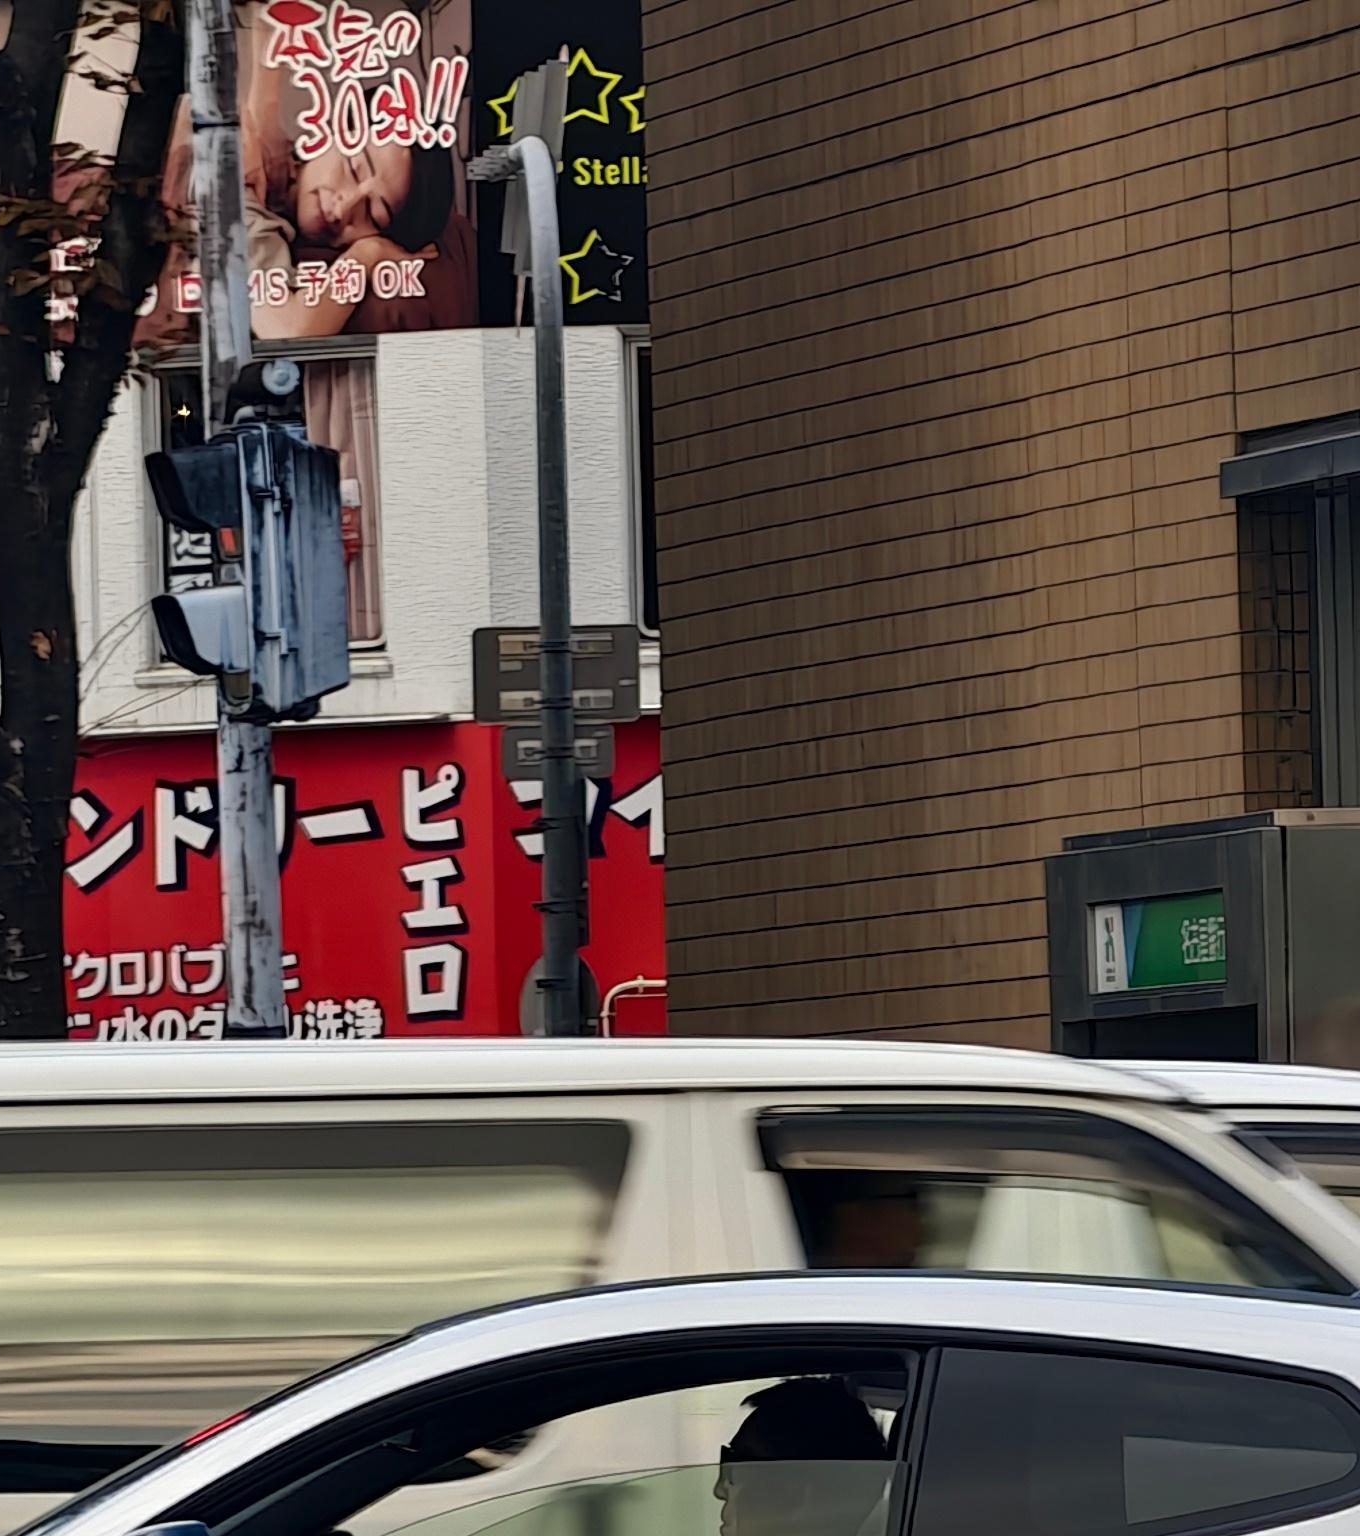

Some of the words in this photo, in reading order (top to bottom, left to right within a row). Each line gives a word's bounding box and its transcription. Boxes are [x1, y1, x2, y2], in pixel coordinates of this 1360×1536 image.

[371, 258, 427, 299] OK
[400, 762, 467, 1017] ピエロ
